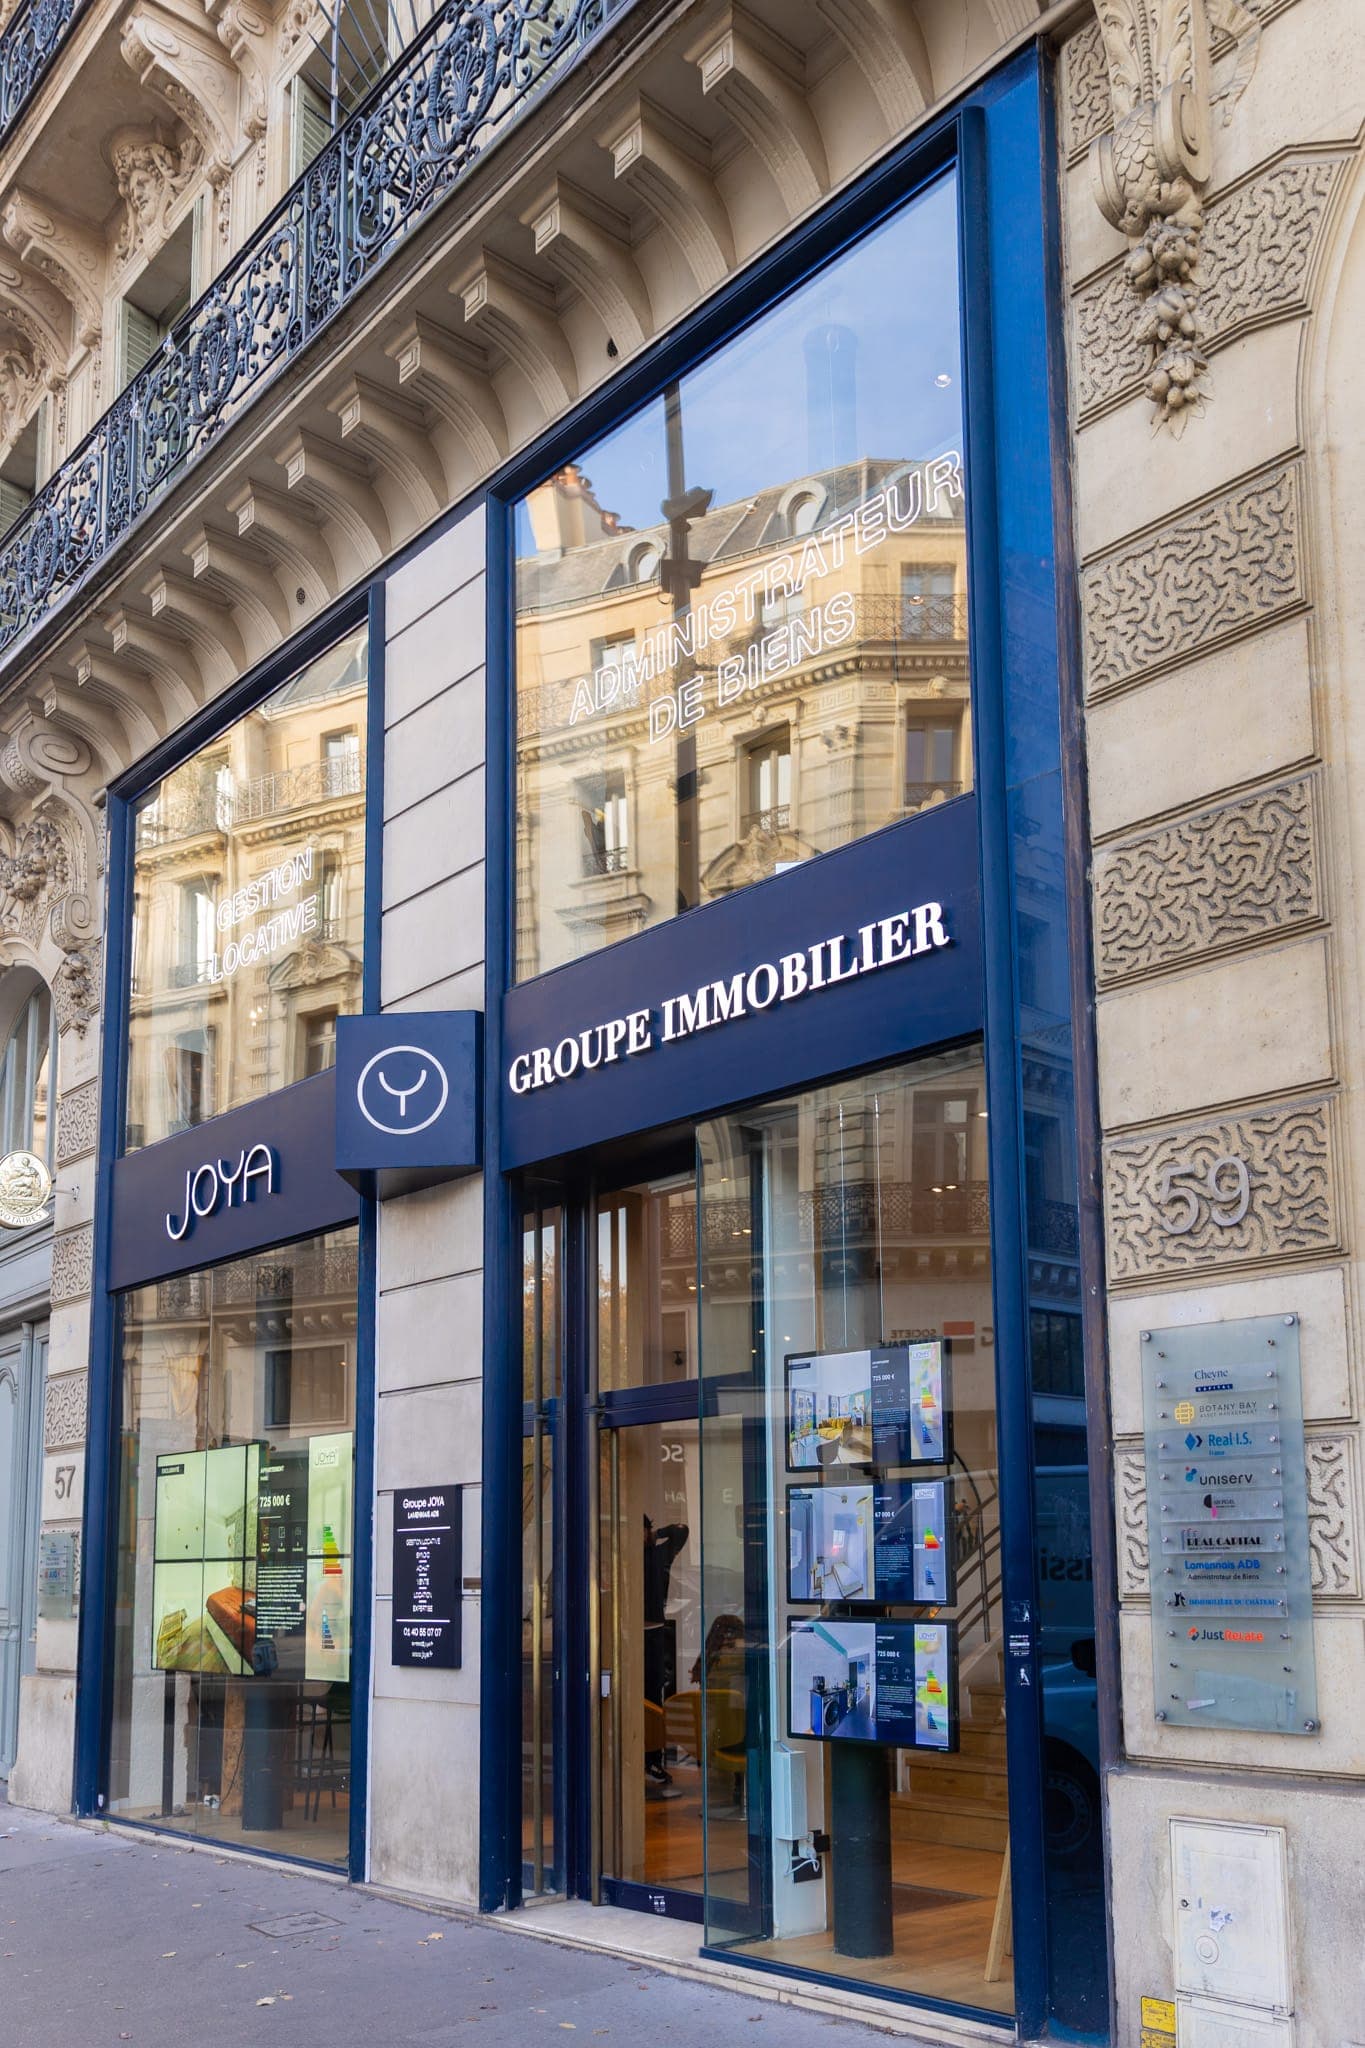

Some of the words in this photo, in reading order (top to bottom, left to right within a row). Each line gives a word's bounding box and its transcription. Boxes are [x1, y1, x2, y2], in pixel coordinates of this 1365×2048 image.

[568, 450, 963, 725] ADMINISTRATEUR
[649, 671, 705, 745] DE
[717, 591, 856, 707] BIENS
[216, 847, 312, 932] GESTION
[210, 895, 317, 984] LOCATIVE
[508, 1008, 652, 1095] GROUPE
[661, 901, 950, 1042] IMMOBILIER
[166, 1143, 275, 1241] JOYA
[1160, 1155, 1251, 1235] 59
[1194, 1369, 1229, 1381] Cheyne
[1200, 1403, 1236, 1413] BOTANY
[1239, 1401, 1257, 1410] BAY
[1208, 1432, 1233, 1446] Real
[55, 1465, 76, 1499] 57
[1200, 1474, 1253, 1486] uniserv
[260, 1496, 271, 1508] 725
[403, 1498, 427, 1510] Groupe
[428, 1496, 445, 1507] JOYA
[1238, 1559, 1261, 1570] ADB
